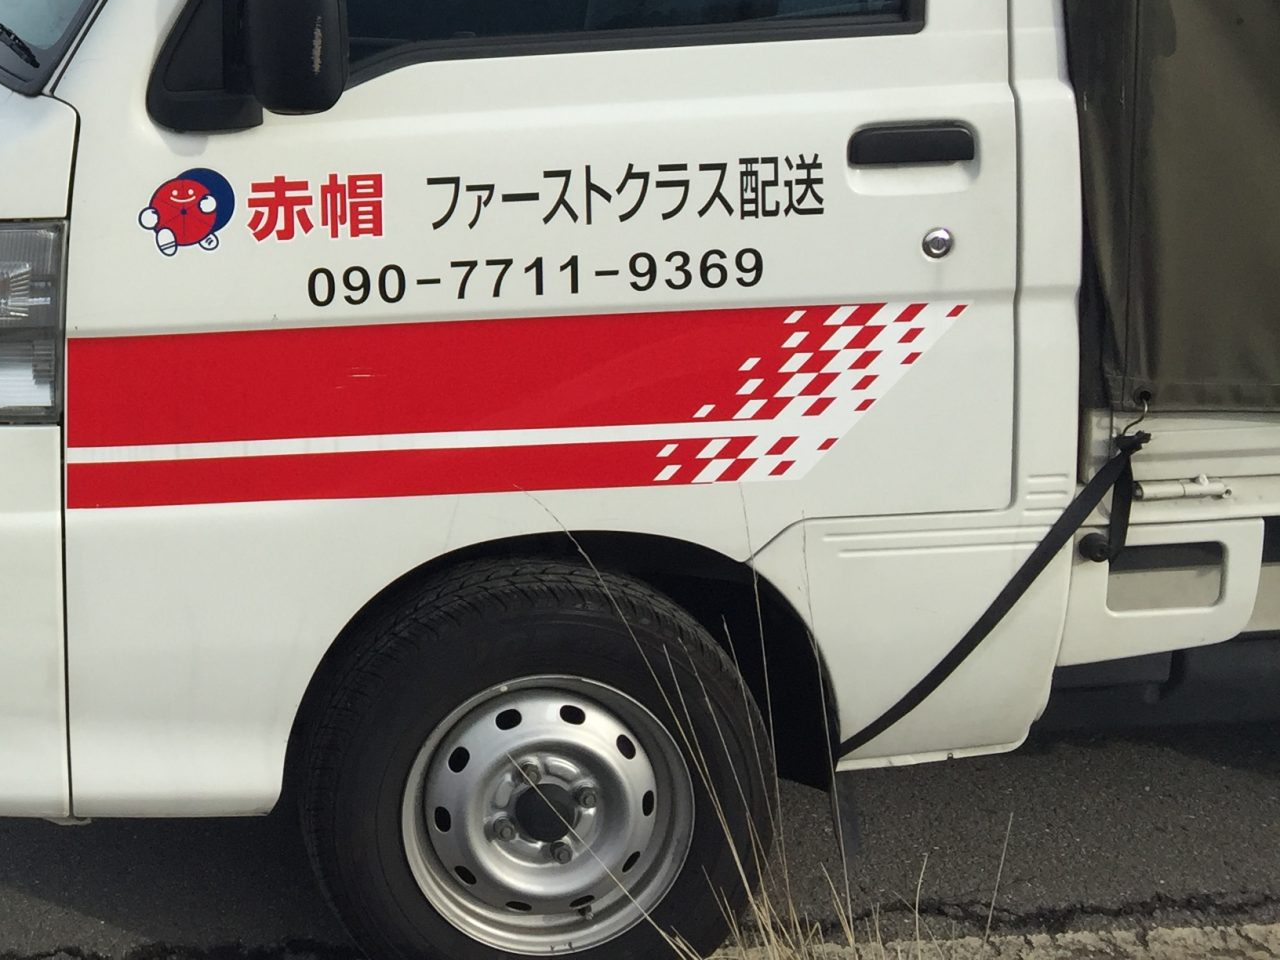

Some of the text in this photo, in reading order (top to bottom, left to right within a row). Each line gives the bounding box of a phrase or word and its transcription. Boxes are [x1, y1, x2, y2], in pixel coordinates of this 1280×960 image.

[248, 153, 825, 241] 赤帽 ファーストクラス配送
[307, 247, 766, 307] 090-7711-9369
